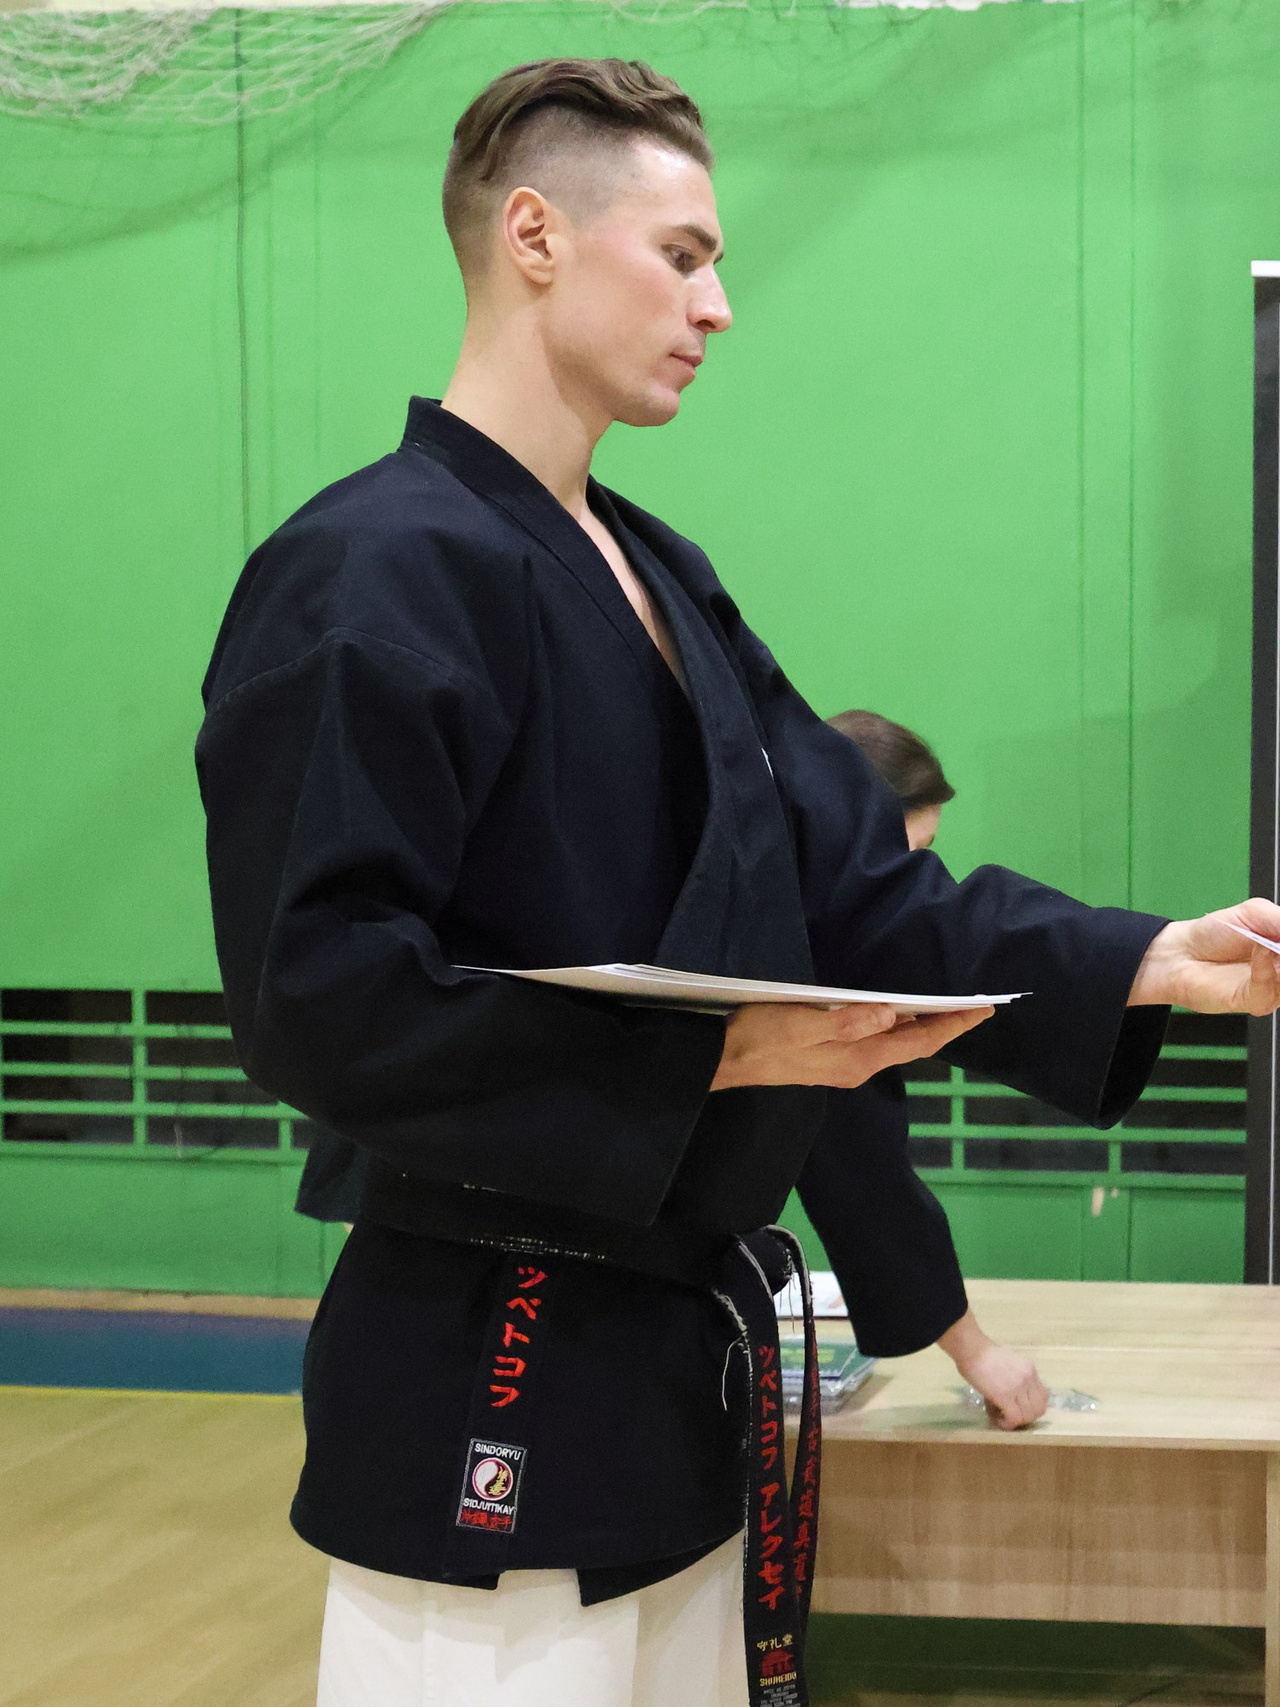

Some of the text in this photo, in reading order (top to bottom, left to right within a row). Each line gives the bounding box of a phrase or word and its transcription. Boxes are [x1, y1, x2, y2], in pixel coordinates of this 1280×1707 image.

[489, 1266, 549, 1408] ツベトコフ
[474, 1443, 522, 1460] SINDORYU
[758, 1345, 785, 1611] ツベトコフ アレクセイ
